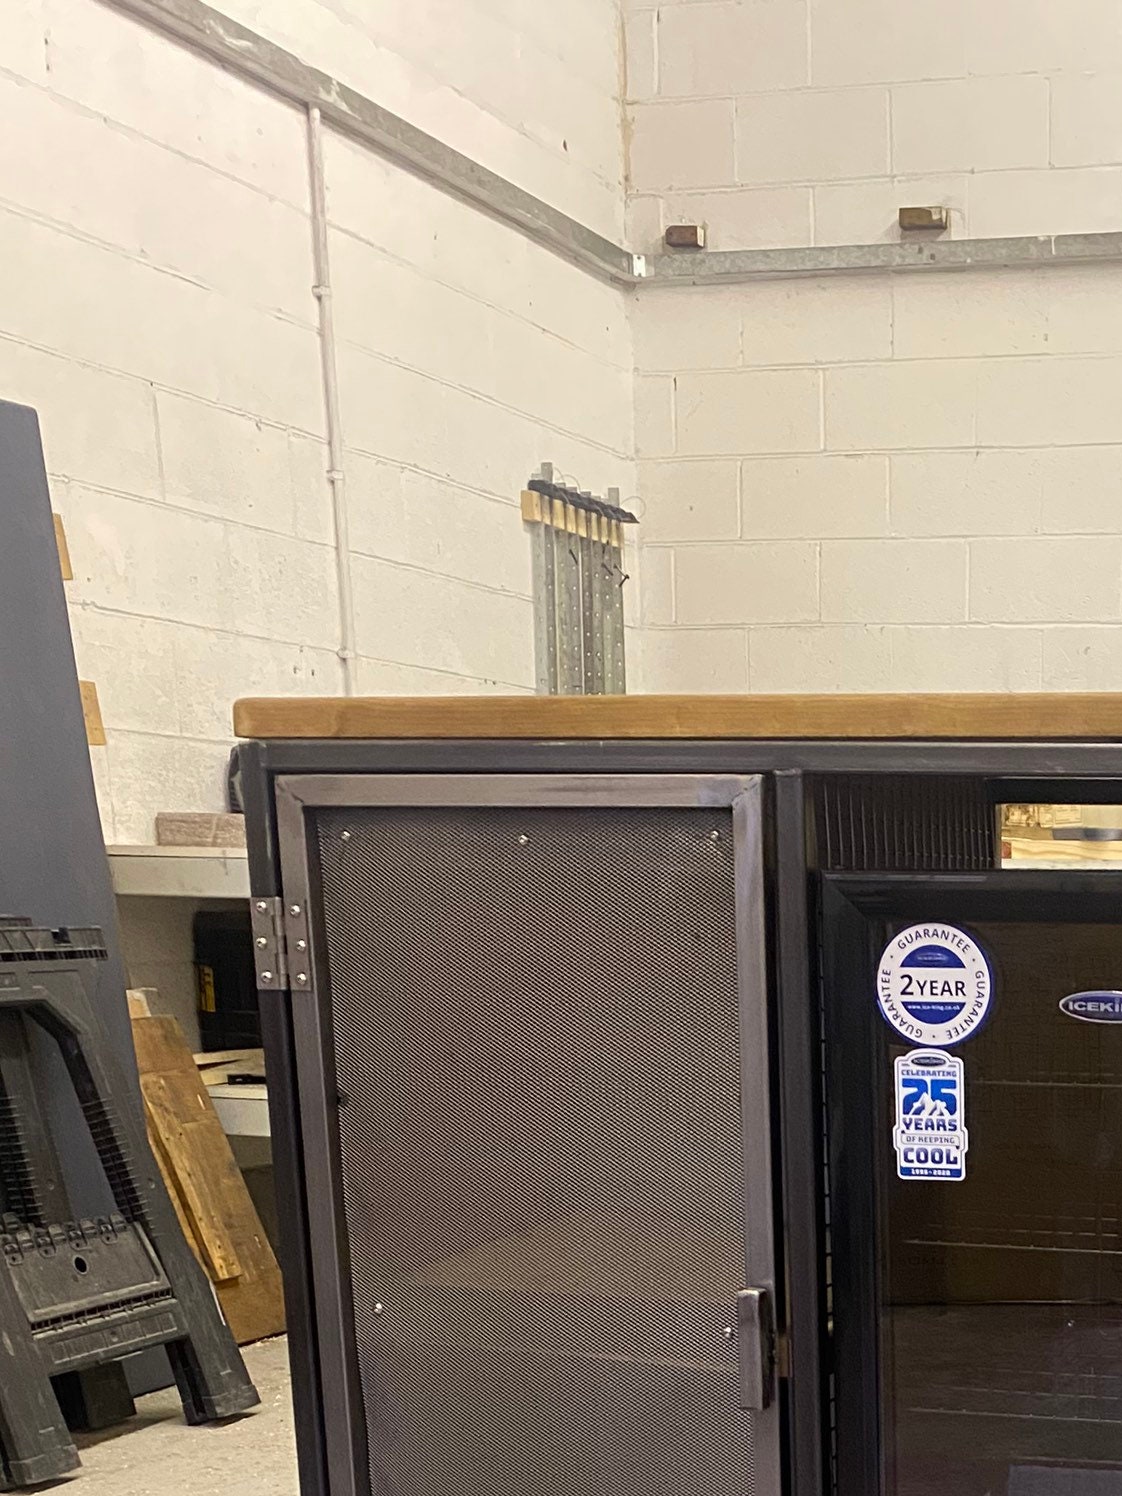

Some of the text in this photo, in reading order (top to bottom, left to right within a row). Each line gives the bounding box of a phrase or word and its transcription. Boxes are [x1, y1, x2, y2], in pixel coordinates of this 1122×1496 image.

[897, 928, 970, 953] GUARANTEE
[881, 969, 923, 1038] GUARANTEE
[946, 970, 985, 1040] GUARANTEE
[901, 1069, 957, 1077] CELEBRATING
[901, 1078, 957, 1116] 25
[902, 1117, 957, 1132] YEARS
[918, 1136, 955, 1144] KEEPING
[903, 1147, 958, 1165] COOL
